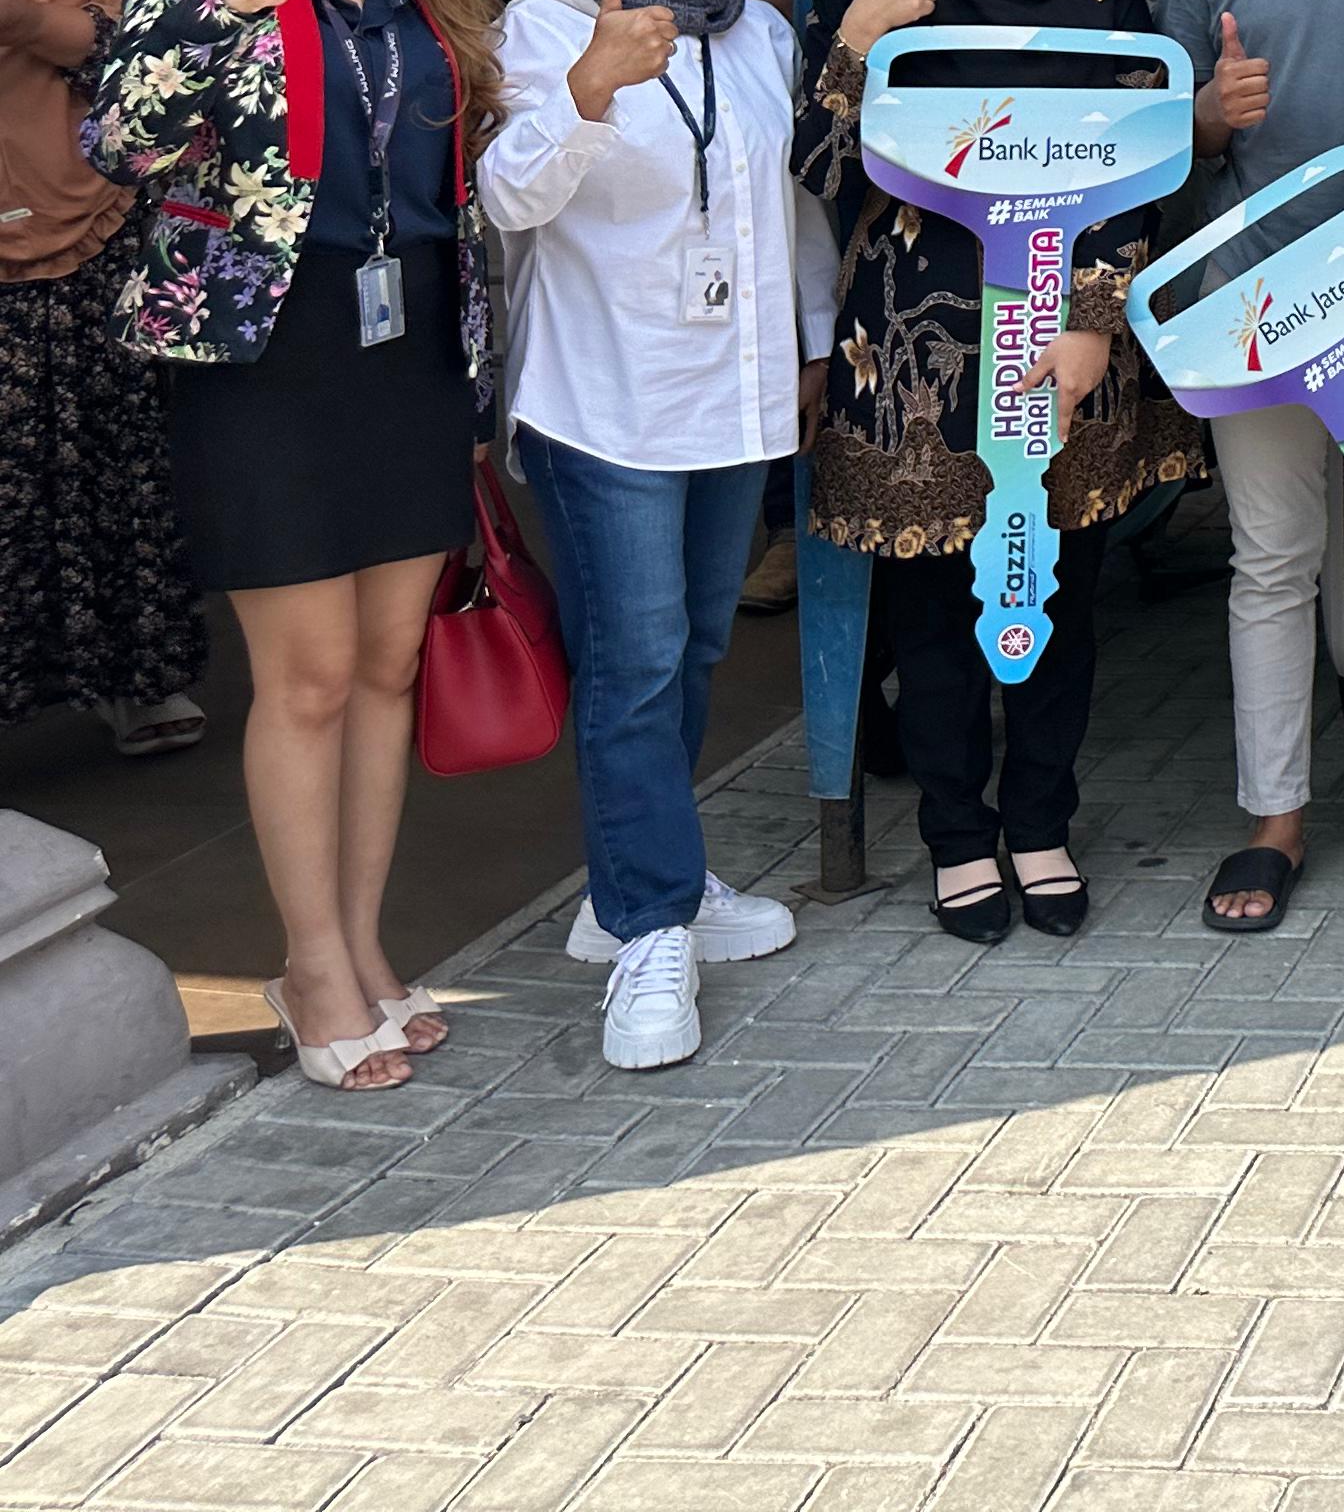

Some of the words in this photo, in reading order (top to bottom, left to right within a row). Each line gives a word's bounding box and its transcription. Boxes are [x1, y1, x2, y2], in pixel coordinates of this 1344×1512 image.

[978, 136, 1038, 161] Bank
[1042, 136, 1117, 167] Jateng
[1013, 209, 1050, 223] BAIK
[1258, 303, 1315, 345] Bank
[994, 303, 1026, 438] HADIAH
[1027, 395, 1049, 456] DARI
[1000, 511, 1026, 608] Fazzio
